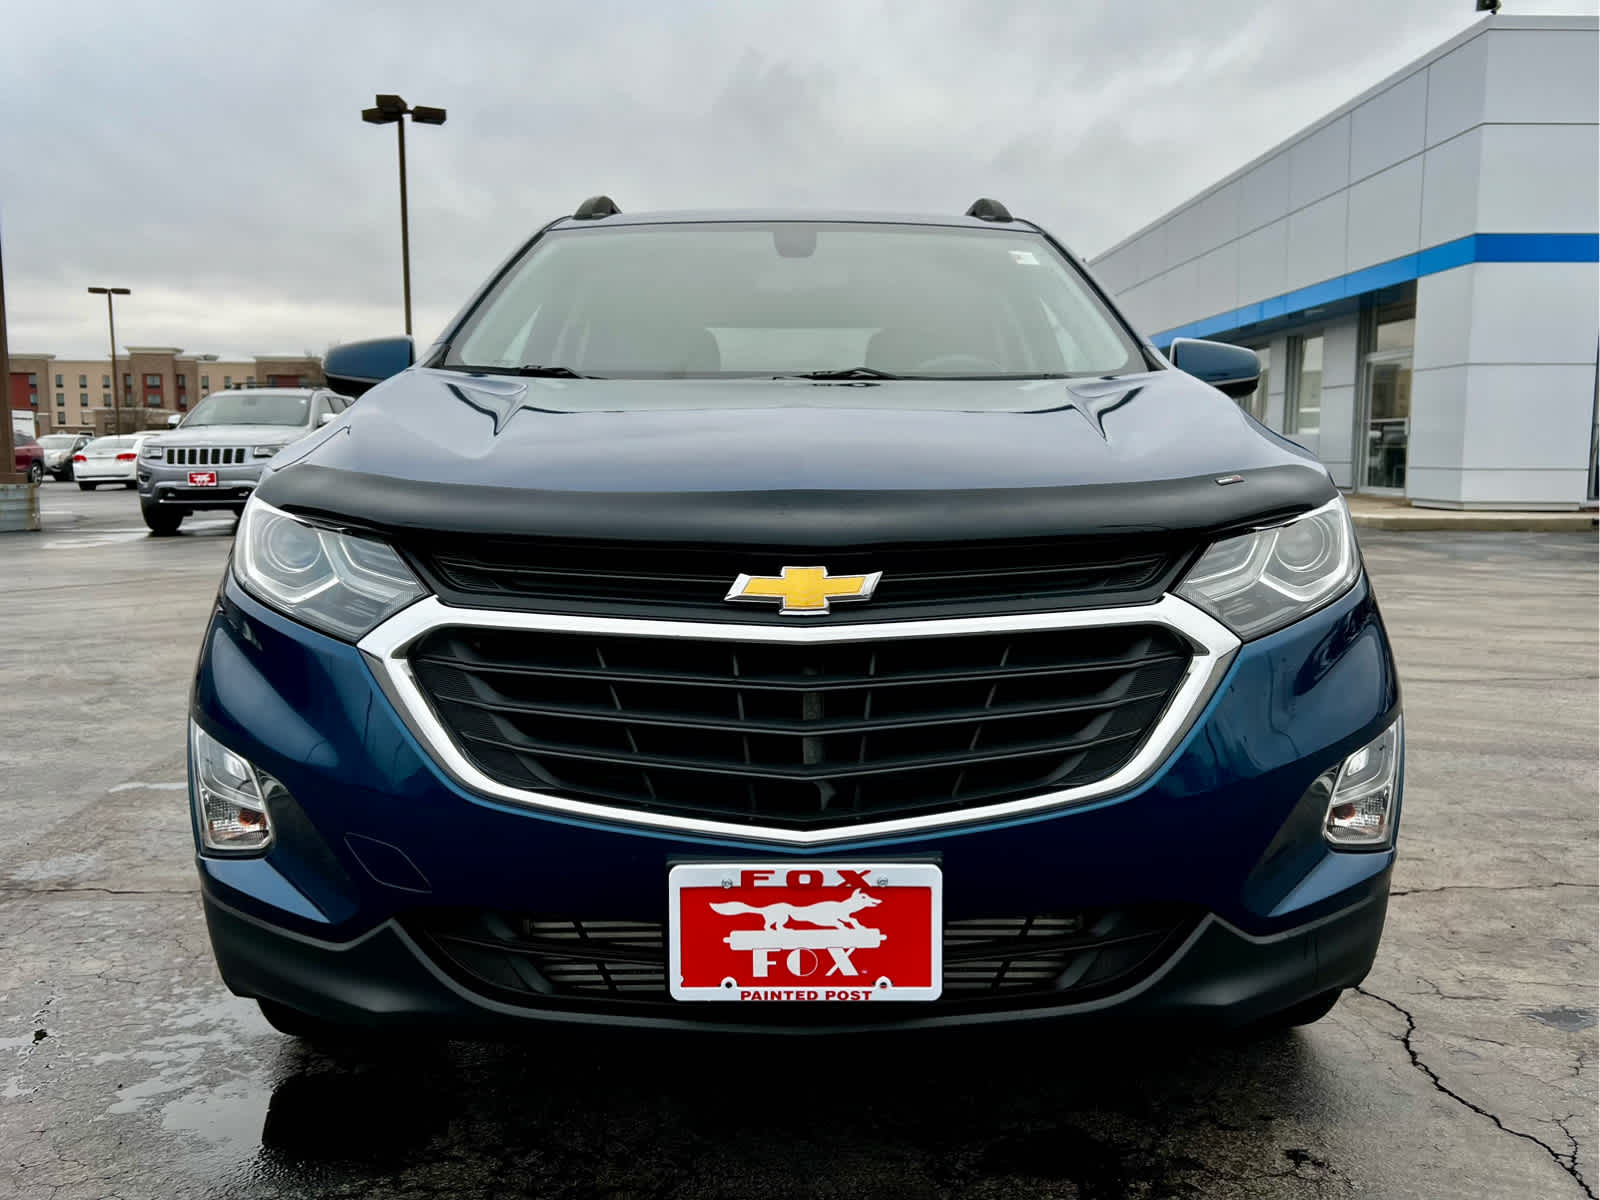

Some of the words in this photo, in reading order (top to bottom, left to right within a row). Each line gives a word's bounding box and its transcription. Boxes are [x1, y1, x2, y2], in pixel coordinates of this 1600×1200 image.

[740, 870, 872, 888] FOX
[752, 947, 859, 977] FOX
[740, 990, 819, 1001] PAINTED
[825, 990, 872, 1001] POST
